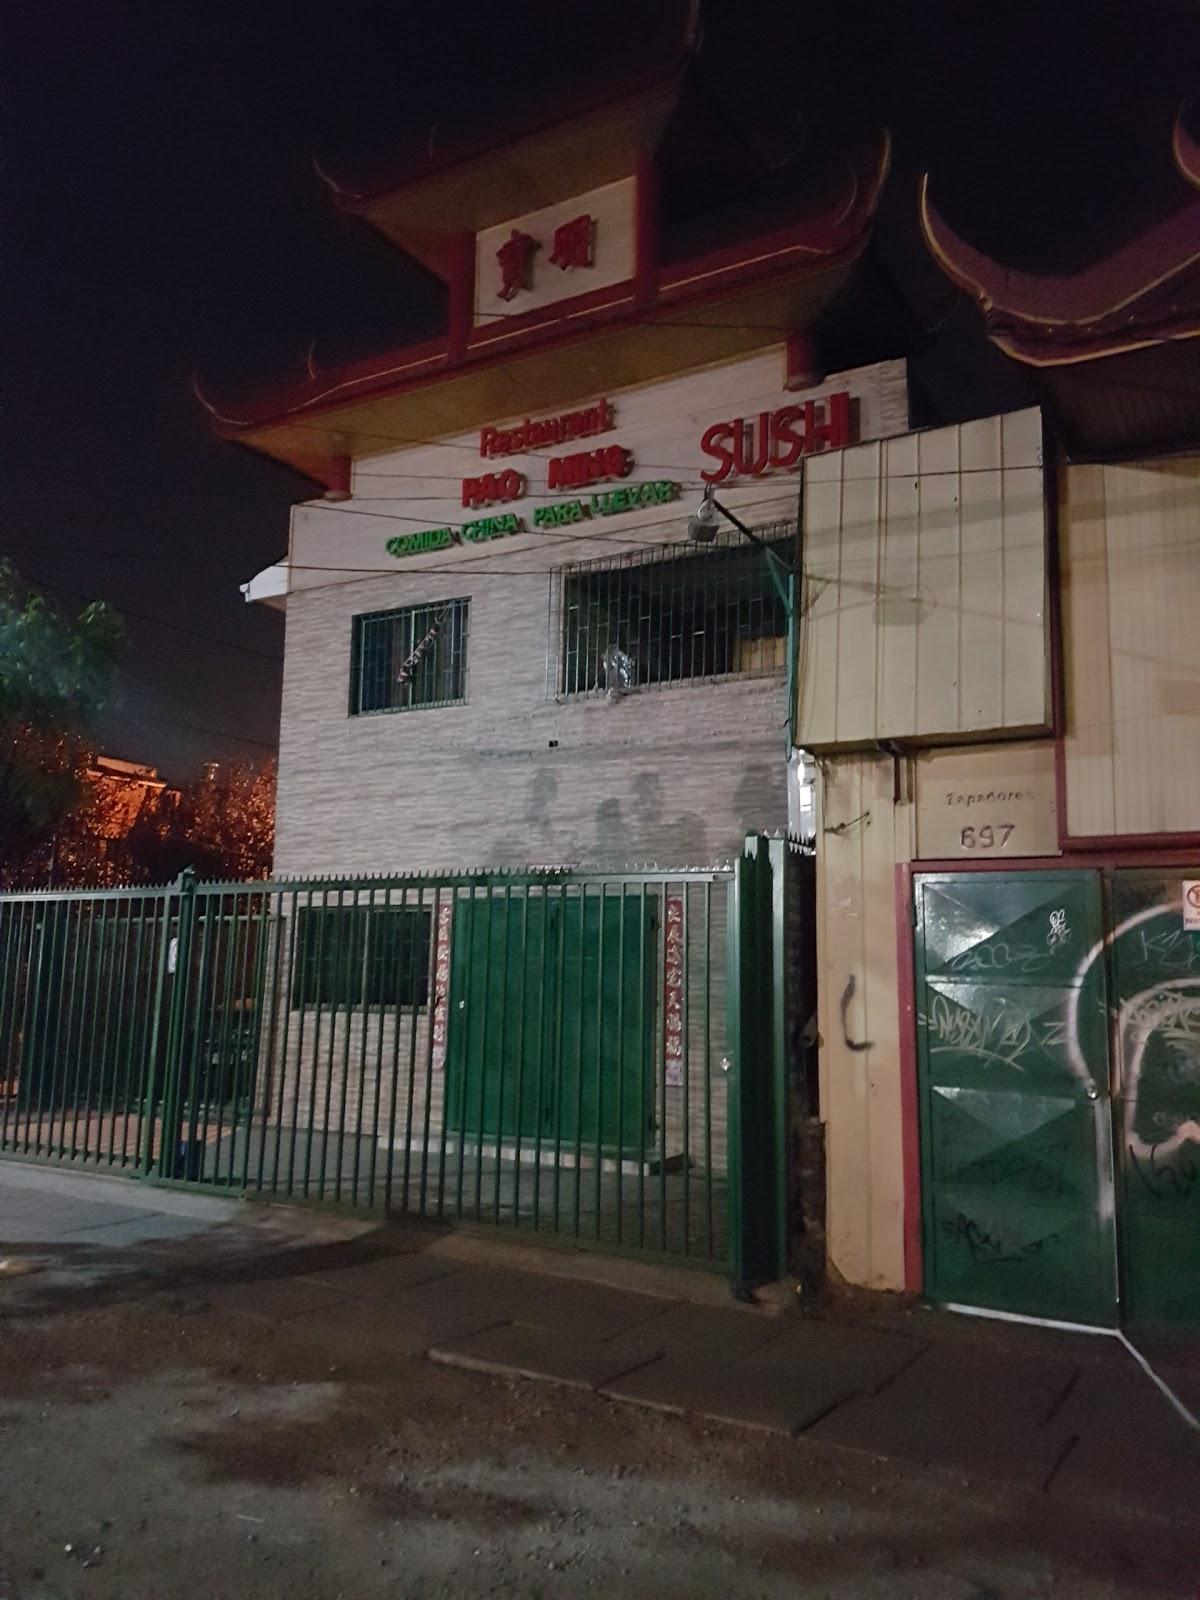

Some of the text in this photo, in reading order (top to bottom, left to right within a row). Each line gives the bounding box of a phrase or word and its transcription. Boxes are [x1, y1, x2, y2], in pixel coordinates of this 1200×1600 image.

[480, 400, 613, 457] Restaurant
[462, 445, 633, 508] PAO MING
[385, 480, 680, 557] COMIDA CHINA PARA LLEVAR
[961, 823, 1015, 849] 697
